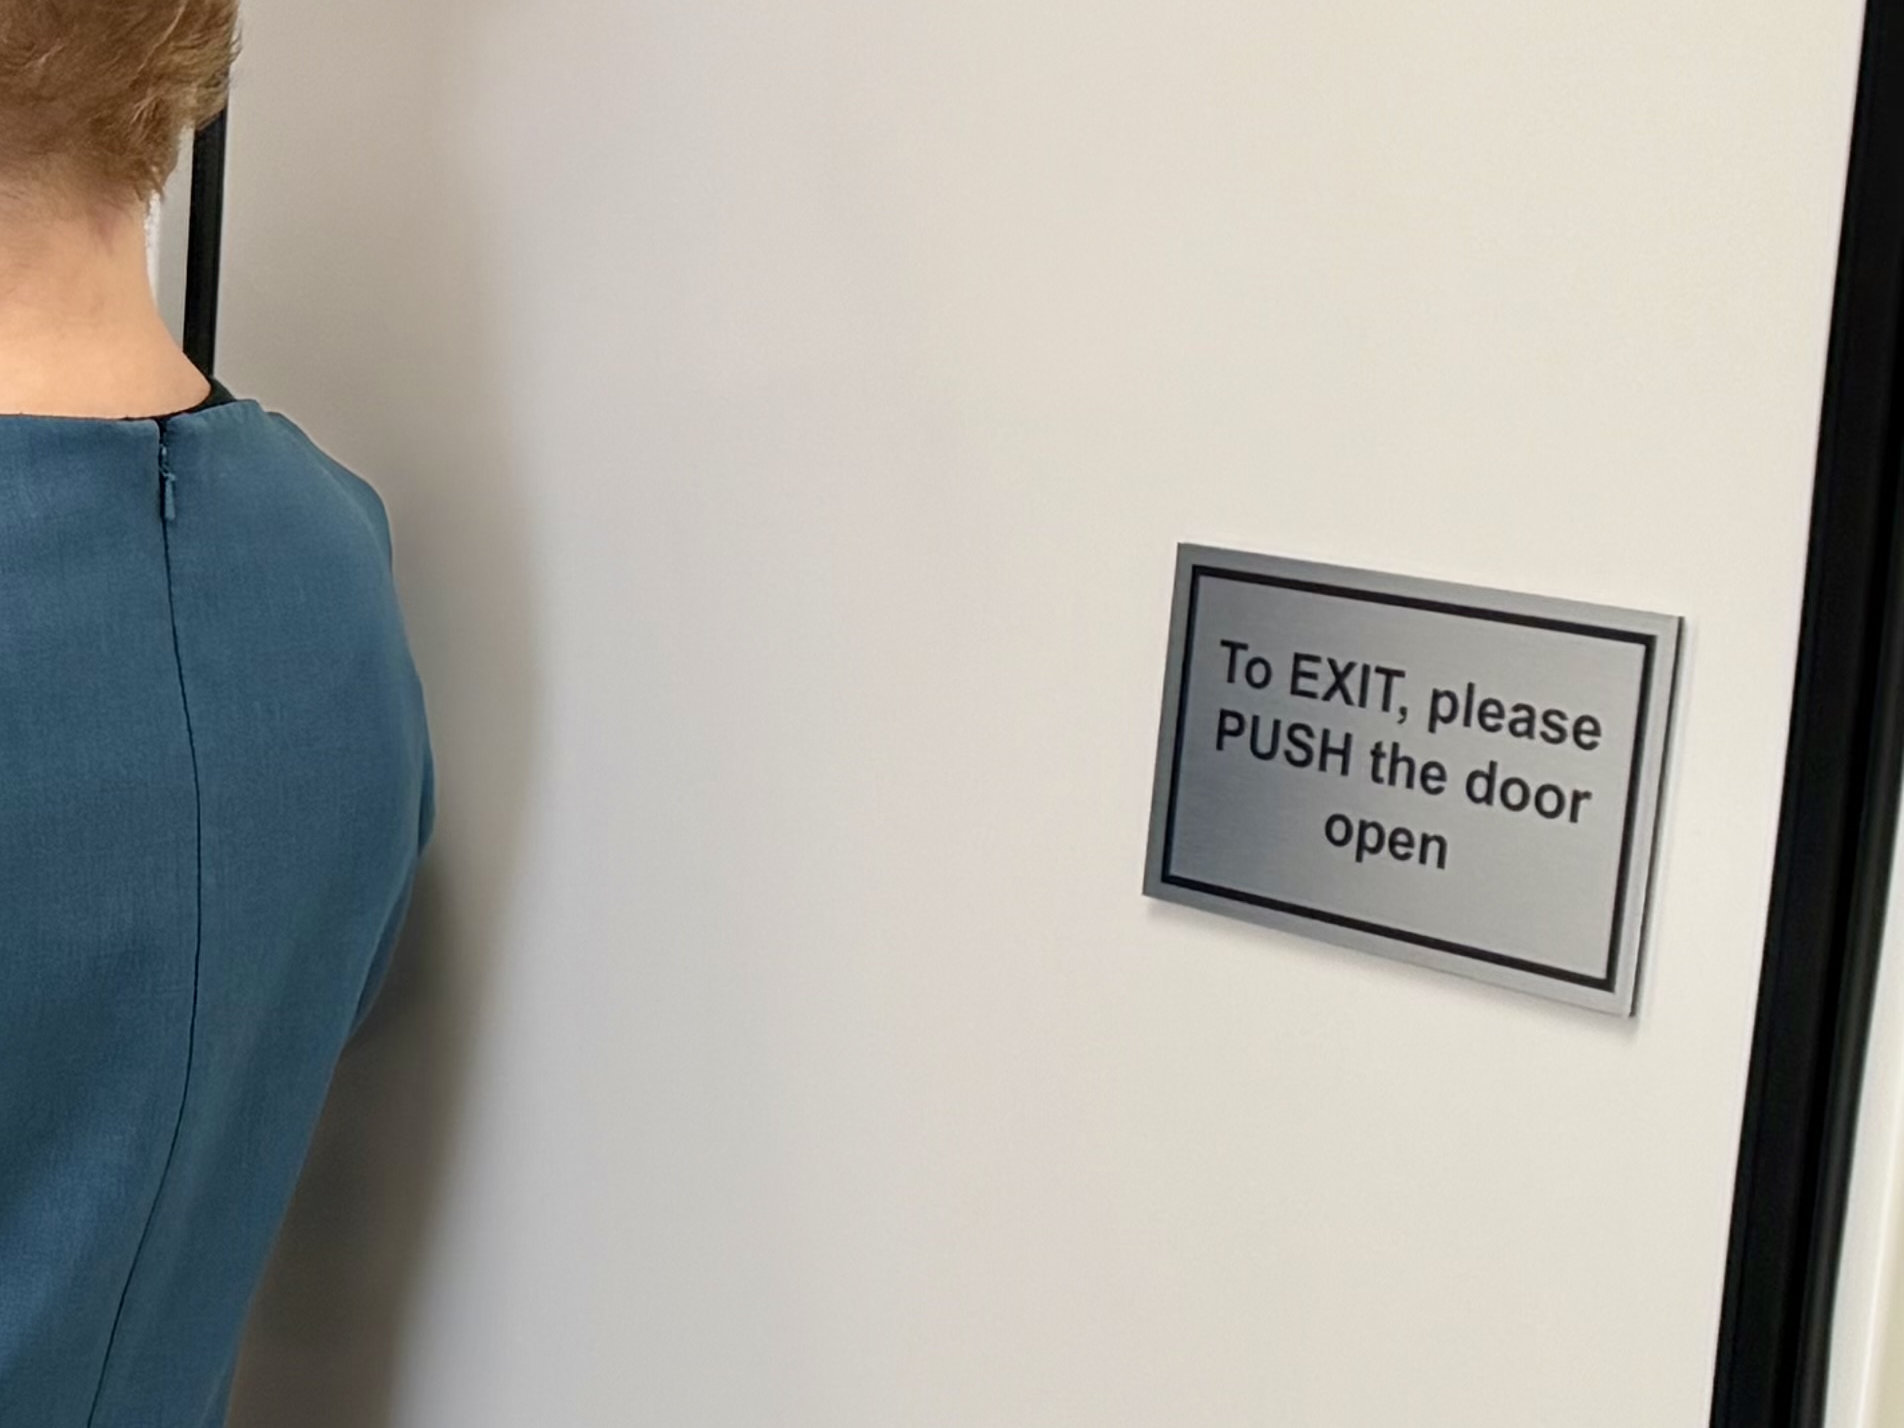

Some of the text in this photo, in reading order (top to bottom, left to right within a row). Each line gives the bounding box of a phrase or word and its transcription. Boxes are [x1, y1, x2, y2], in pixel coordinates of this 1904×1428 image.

[1219, 639, 1603, 752] To EXIT, please
[1215, 708, 1593, 824] PUSH the door
[1323, 811, 1449, 870] open
